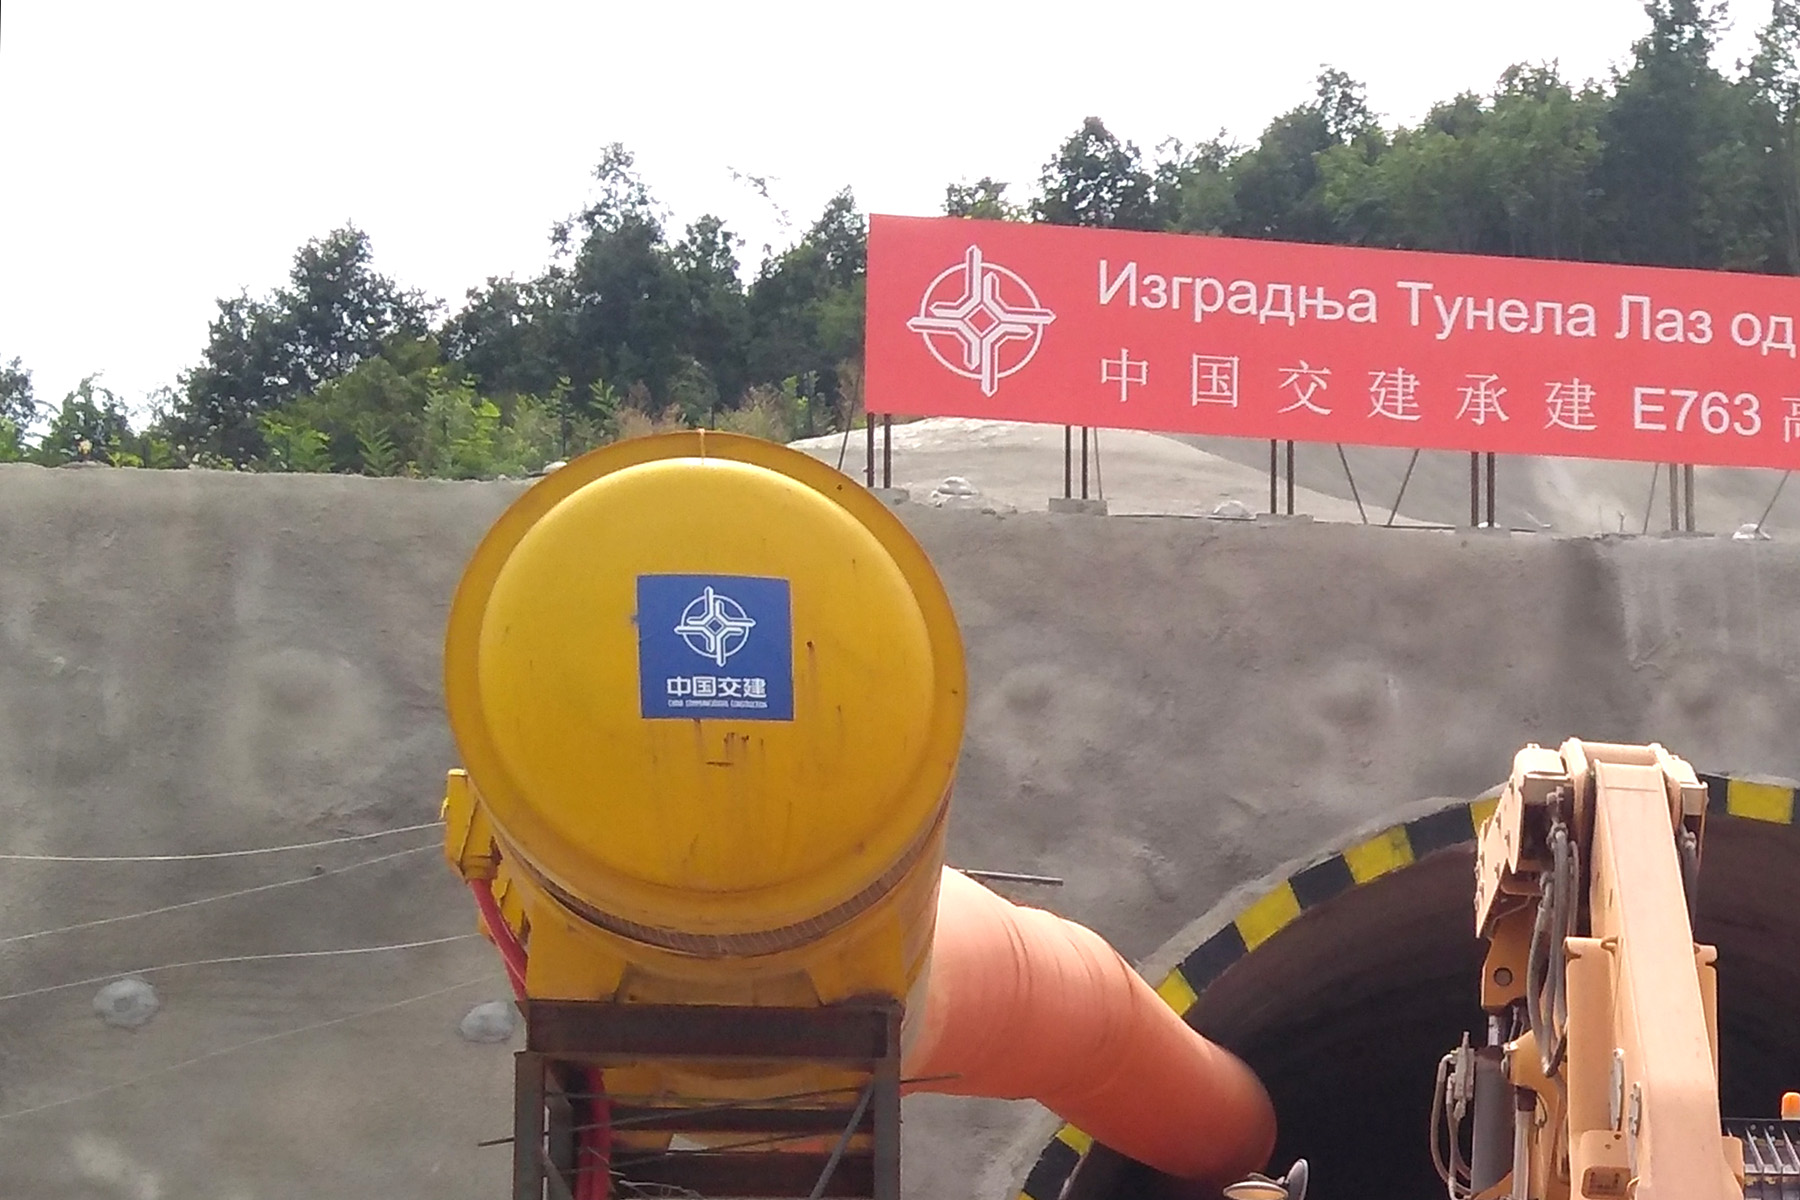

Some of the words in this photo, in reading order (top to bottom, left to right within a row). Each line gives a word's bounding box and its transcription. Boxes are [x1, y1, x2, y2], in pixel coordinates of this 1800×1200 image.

[1100, 259, 1378, 326] Изградња
[1396, 280, 1597, 340] Тунела
[1614, 294, 1713, 344] Лаз
[1730, 312, 1797, 359] од
[1633, 386, 1762, 436] E763
[667, 676, 767, 698] 中国交建
